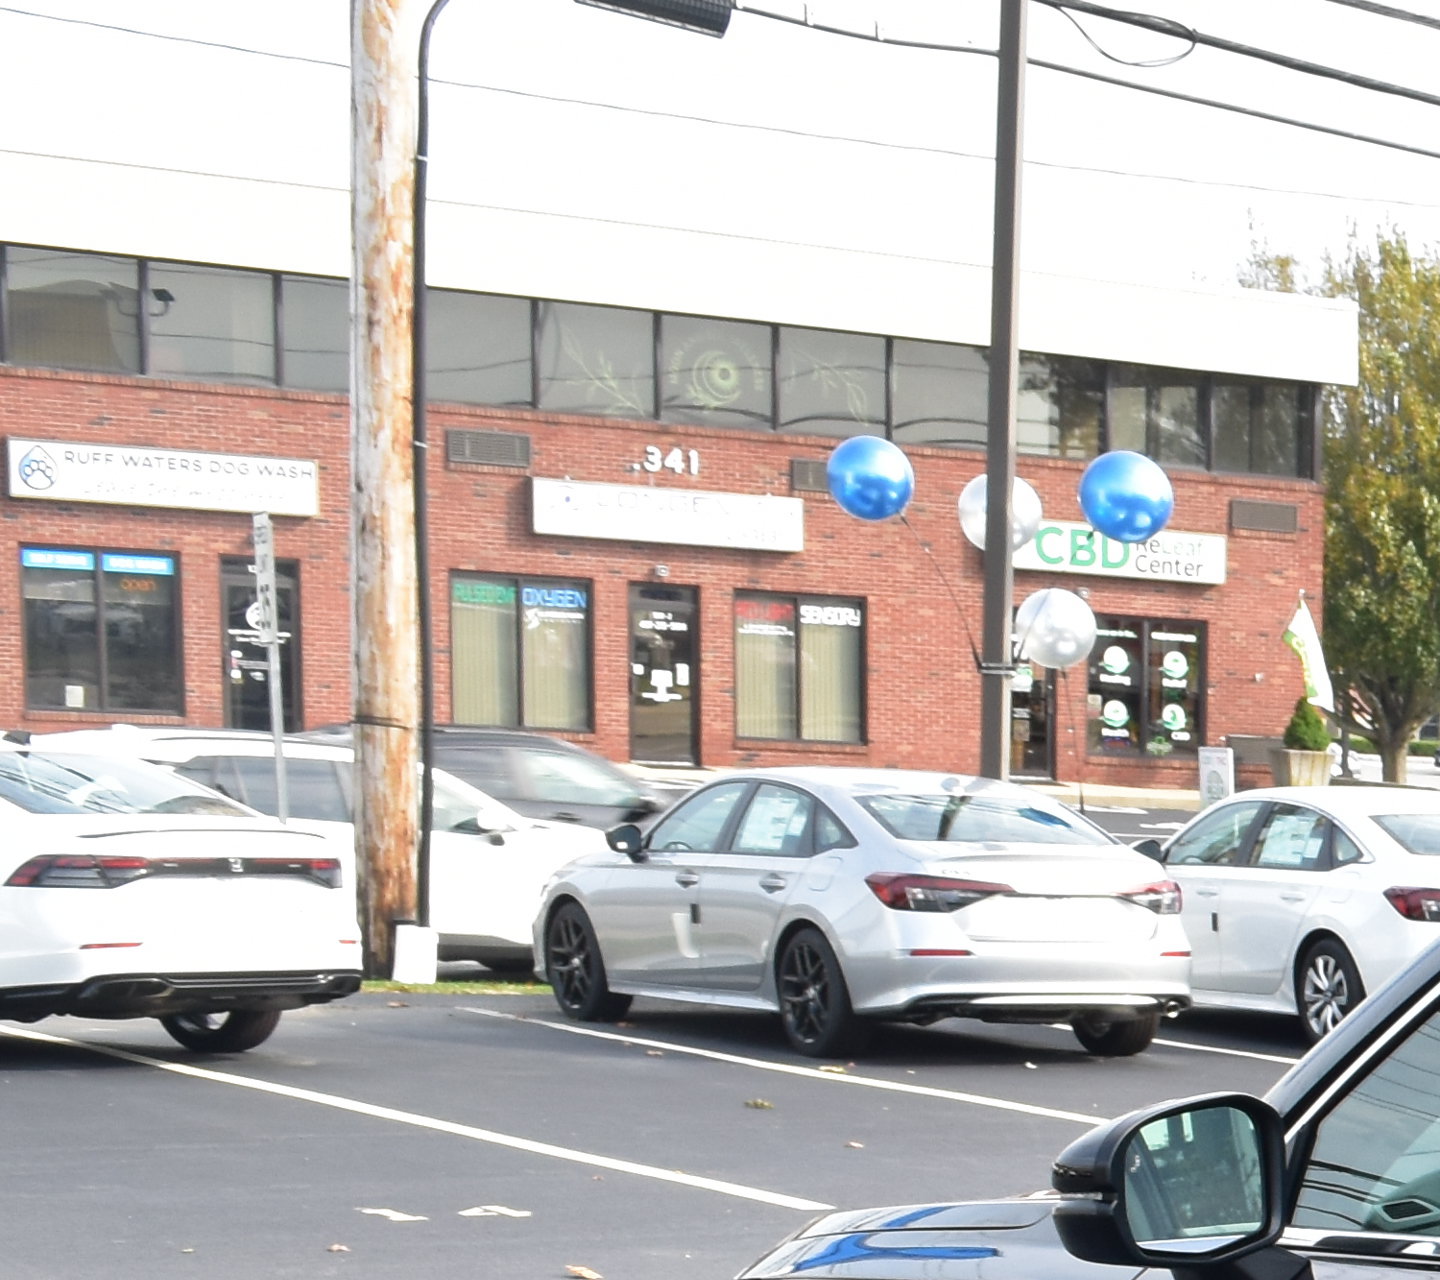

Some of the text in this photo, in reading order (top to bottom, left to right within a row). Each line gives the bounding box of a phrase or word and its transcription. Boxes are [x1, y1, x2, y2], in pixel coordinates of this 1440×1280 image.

[63, 450, 313, 479] RUFF WATERS DOG WASH
[644, 445, 699, 475] 341
[1035, 527, 1130, 569] CBD
[1135, 554, 1204, 577] Center
[522, 587, 587, 609] OXYGEN
[799, 604, 862, 628] SENSORY
